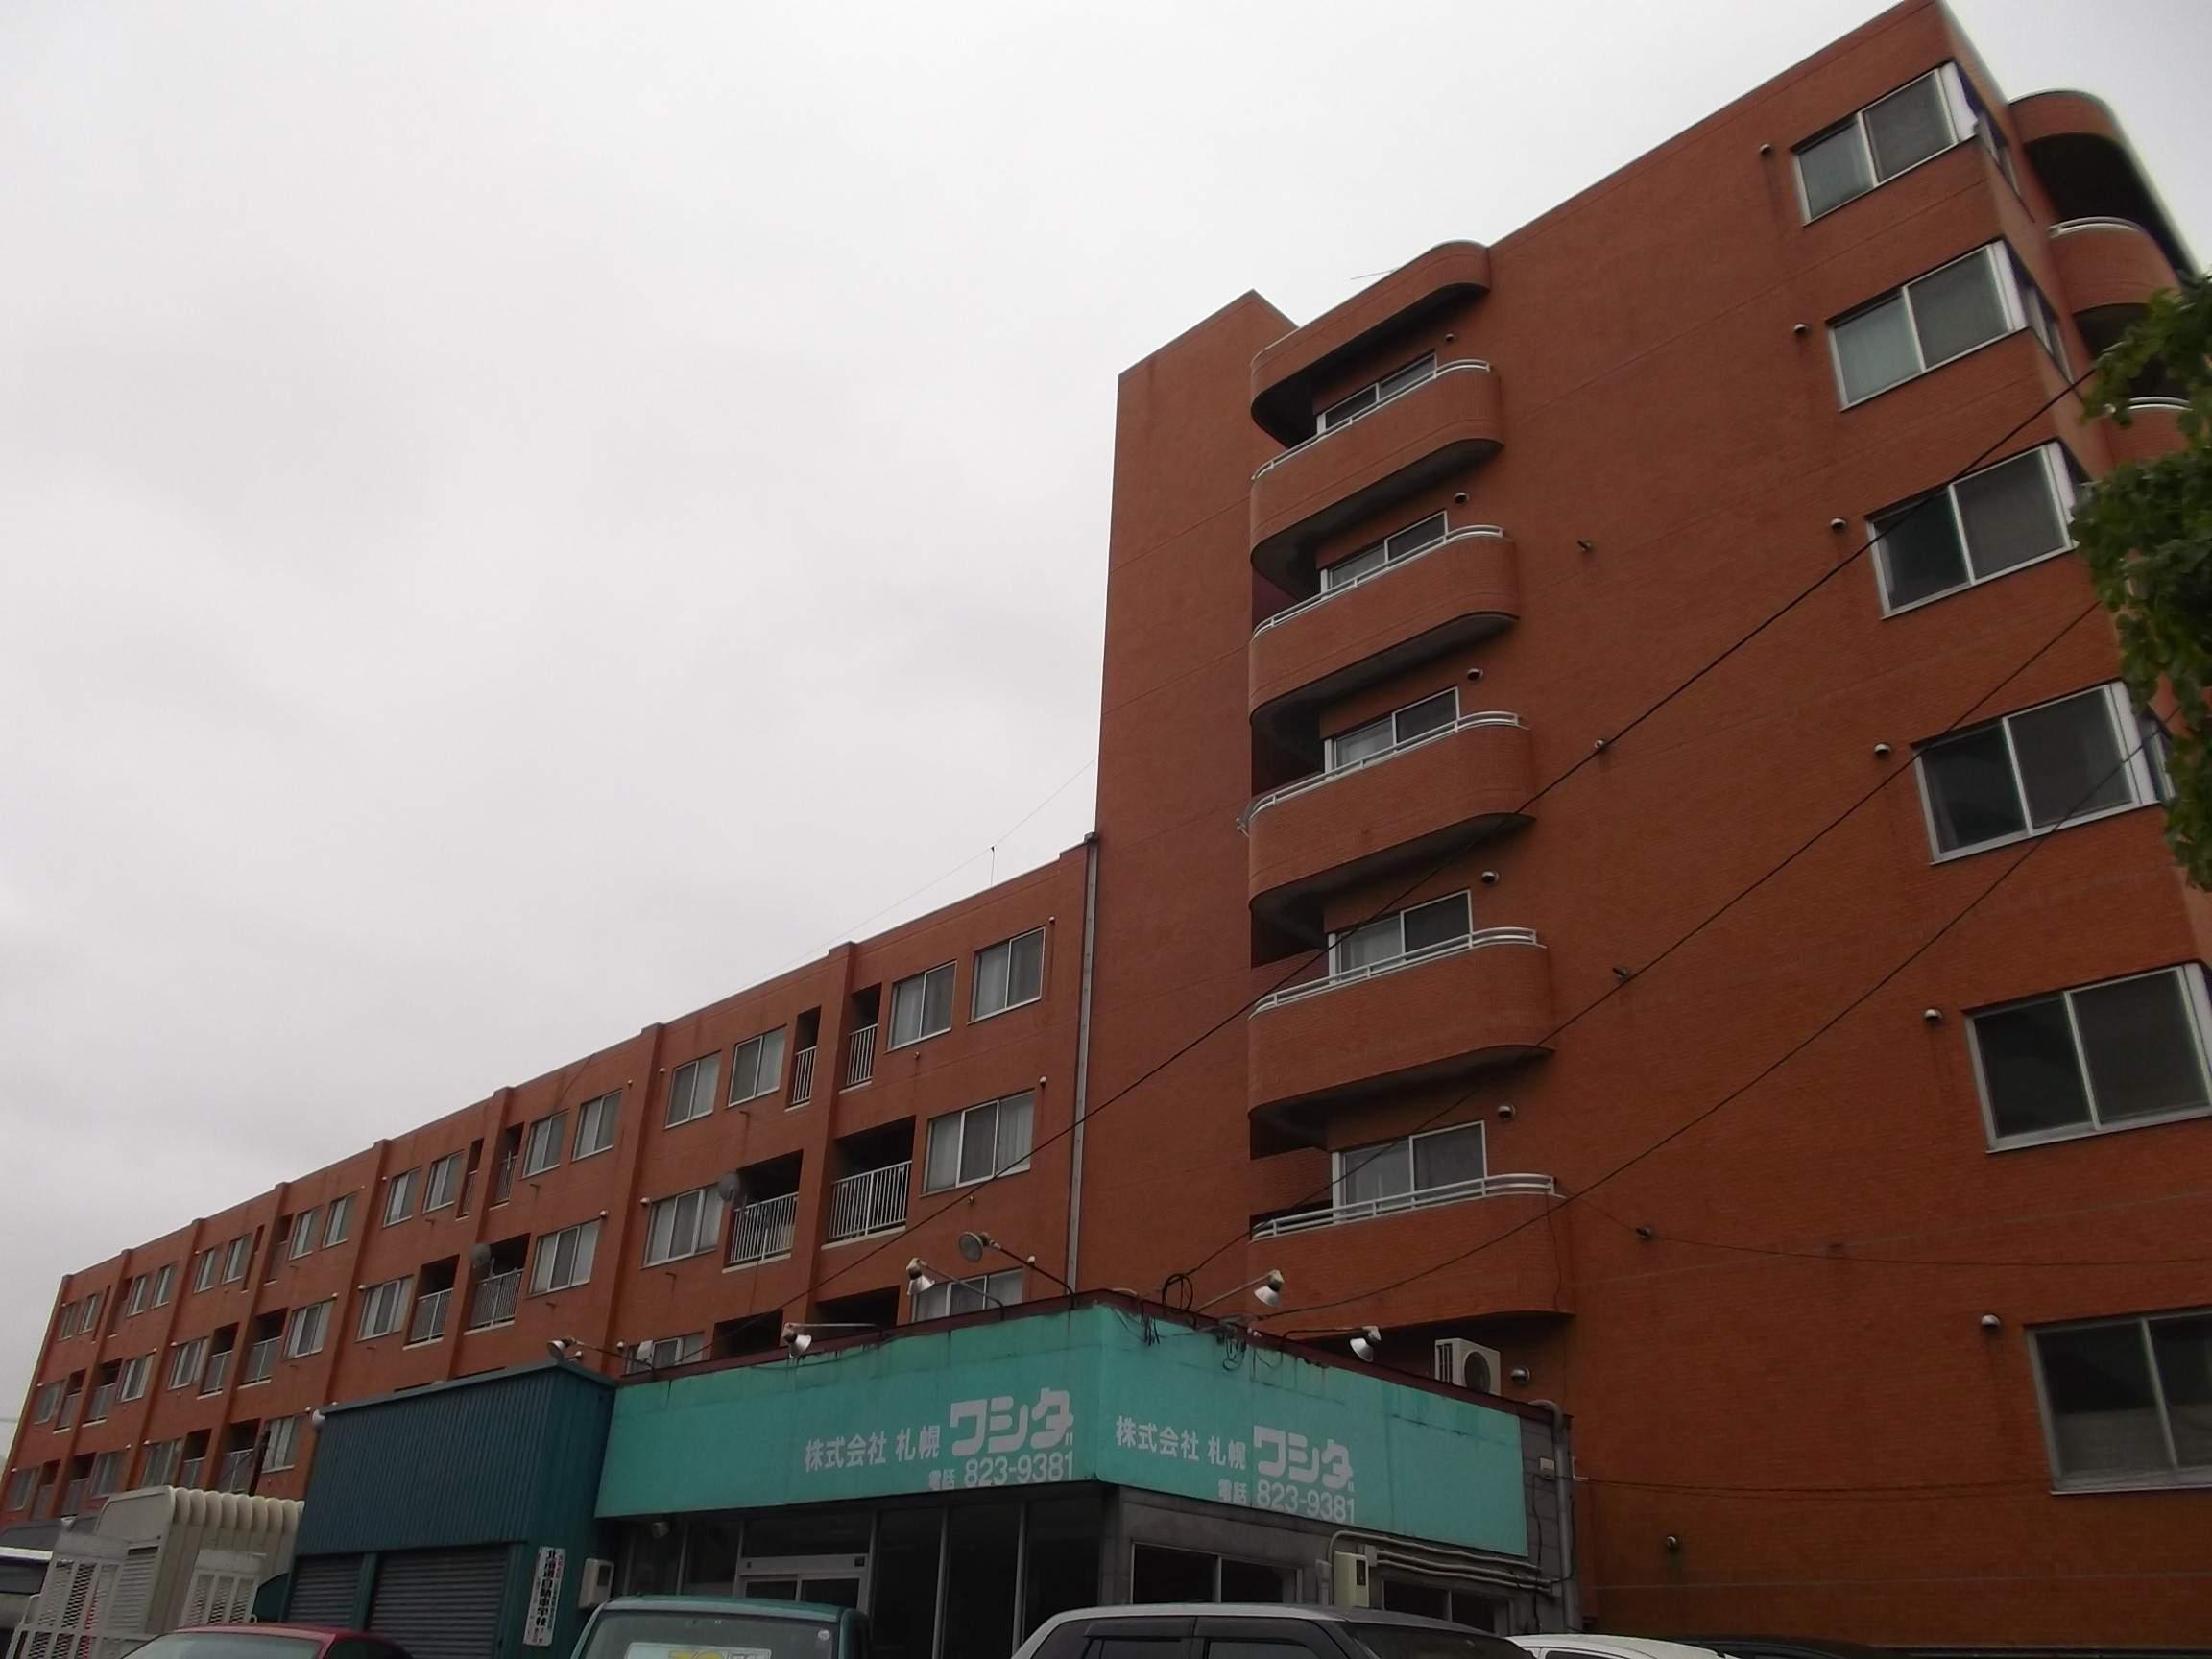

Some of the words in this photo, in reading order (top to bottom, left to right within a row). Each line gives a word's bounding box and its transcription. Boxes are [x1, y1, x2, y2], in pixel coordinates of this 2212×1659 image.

[805, 1431, 887, 1472] 株式会社
[895, 1425, 941, 1462] 札幌
[1116, 1415, 1199, 1461] 株式会社
[1208, 1436, 1246, 1470] 札幌
[964, 1450, 1074, 1487] 823-9381
[1256, 1479, 1356, 1524] 823-9381
